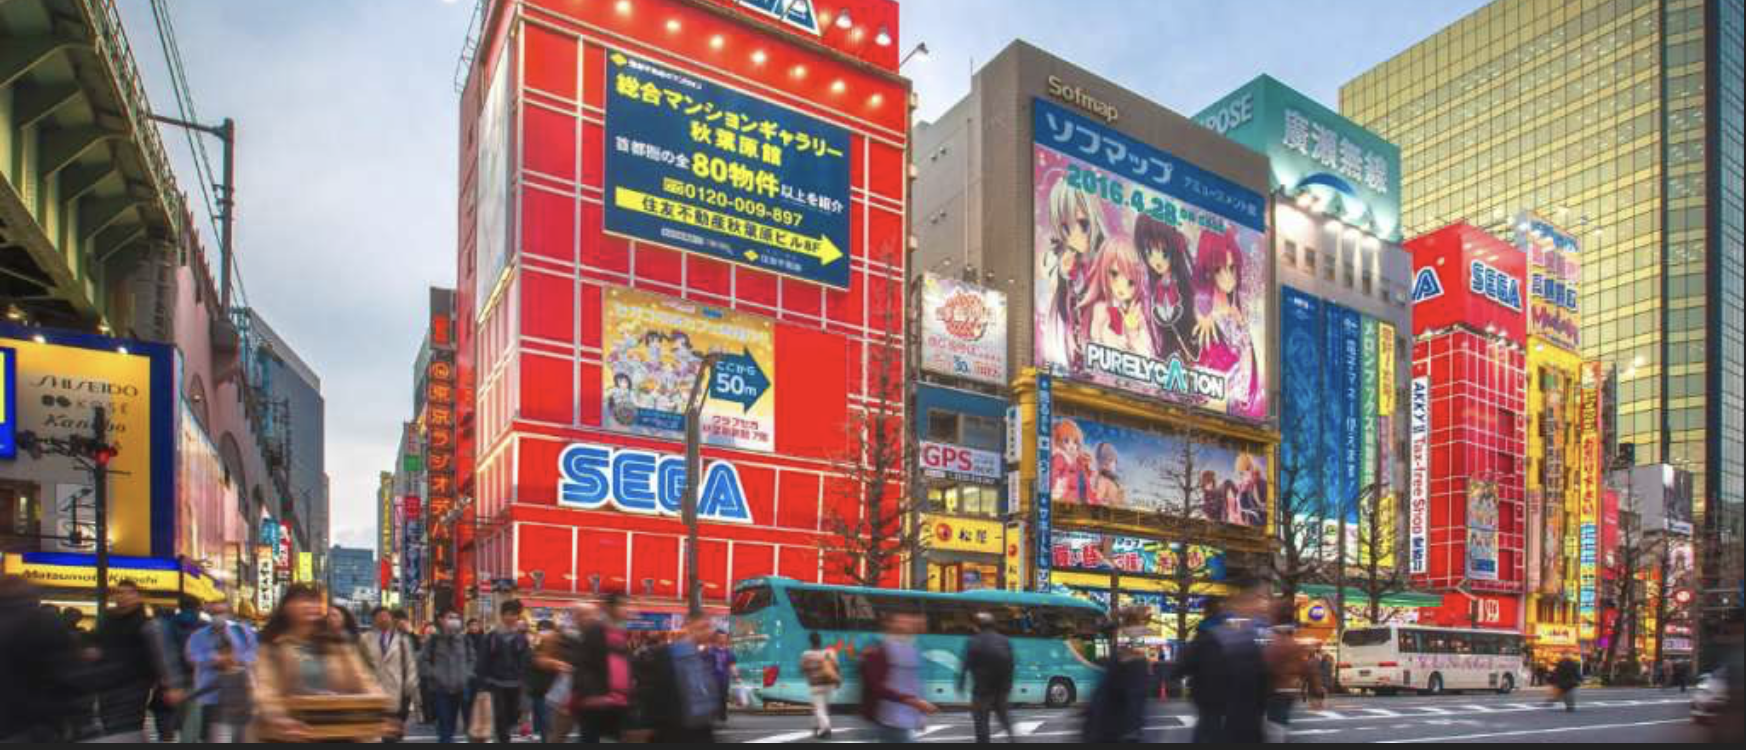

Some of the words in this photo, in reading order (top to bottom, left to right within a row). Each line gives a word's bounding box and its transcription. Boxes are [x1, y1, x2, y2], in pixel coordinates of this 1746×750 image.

[615, 73, 844, 158] 総合マンションギャラリー
[1047, 73, 1119, 122] Sofmap
[1046, 112, 1174, 185] ソフマップ
[1471, 258, 1522, 314] SEGA
[29, 374, 139, 397] SHISEIDO
[1413, 381, 1425, 421] AKKY
[44, 413, 127, 432] Kanbo
[923, 444, 972, 471] GPS
[559, 444, 753, 524] SEGA
[24, 569, 99, 581] Matsumot
[108, 572, 158, 586] Kioshi
